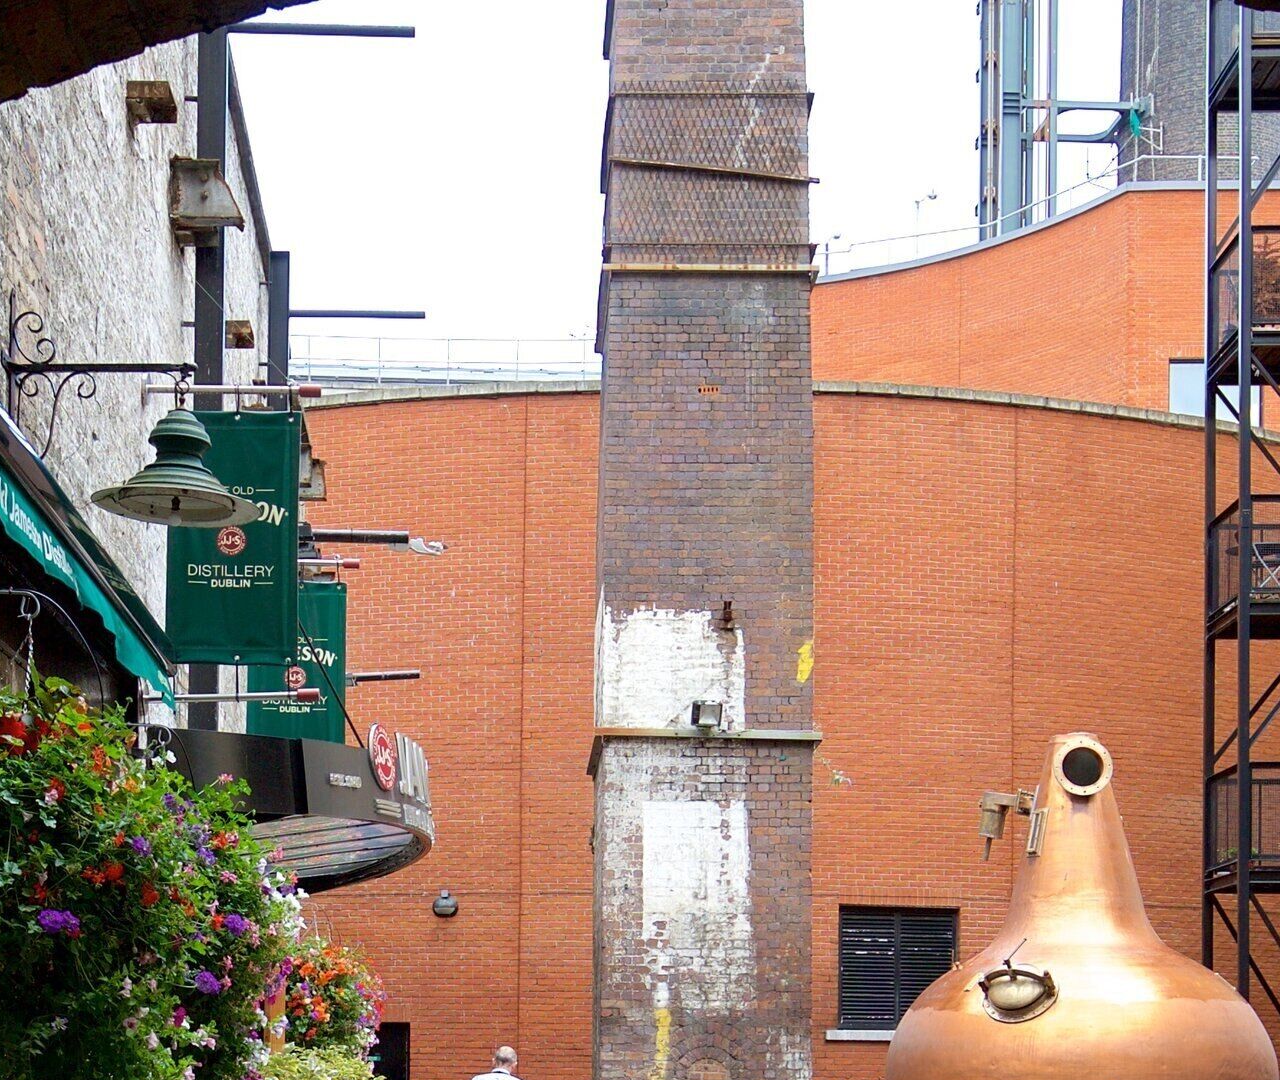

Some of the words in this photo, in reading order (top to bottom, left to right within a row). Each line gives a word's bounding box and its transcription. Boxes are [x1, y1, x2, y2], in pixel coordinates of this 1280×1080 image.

[232, 486, 254, 495] OLD
[10, 491, 43, 553] Jameson
[187, 563, 274, 578] DISTILLERY
[211, 579, 251, 588] DUBLIN
